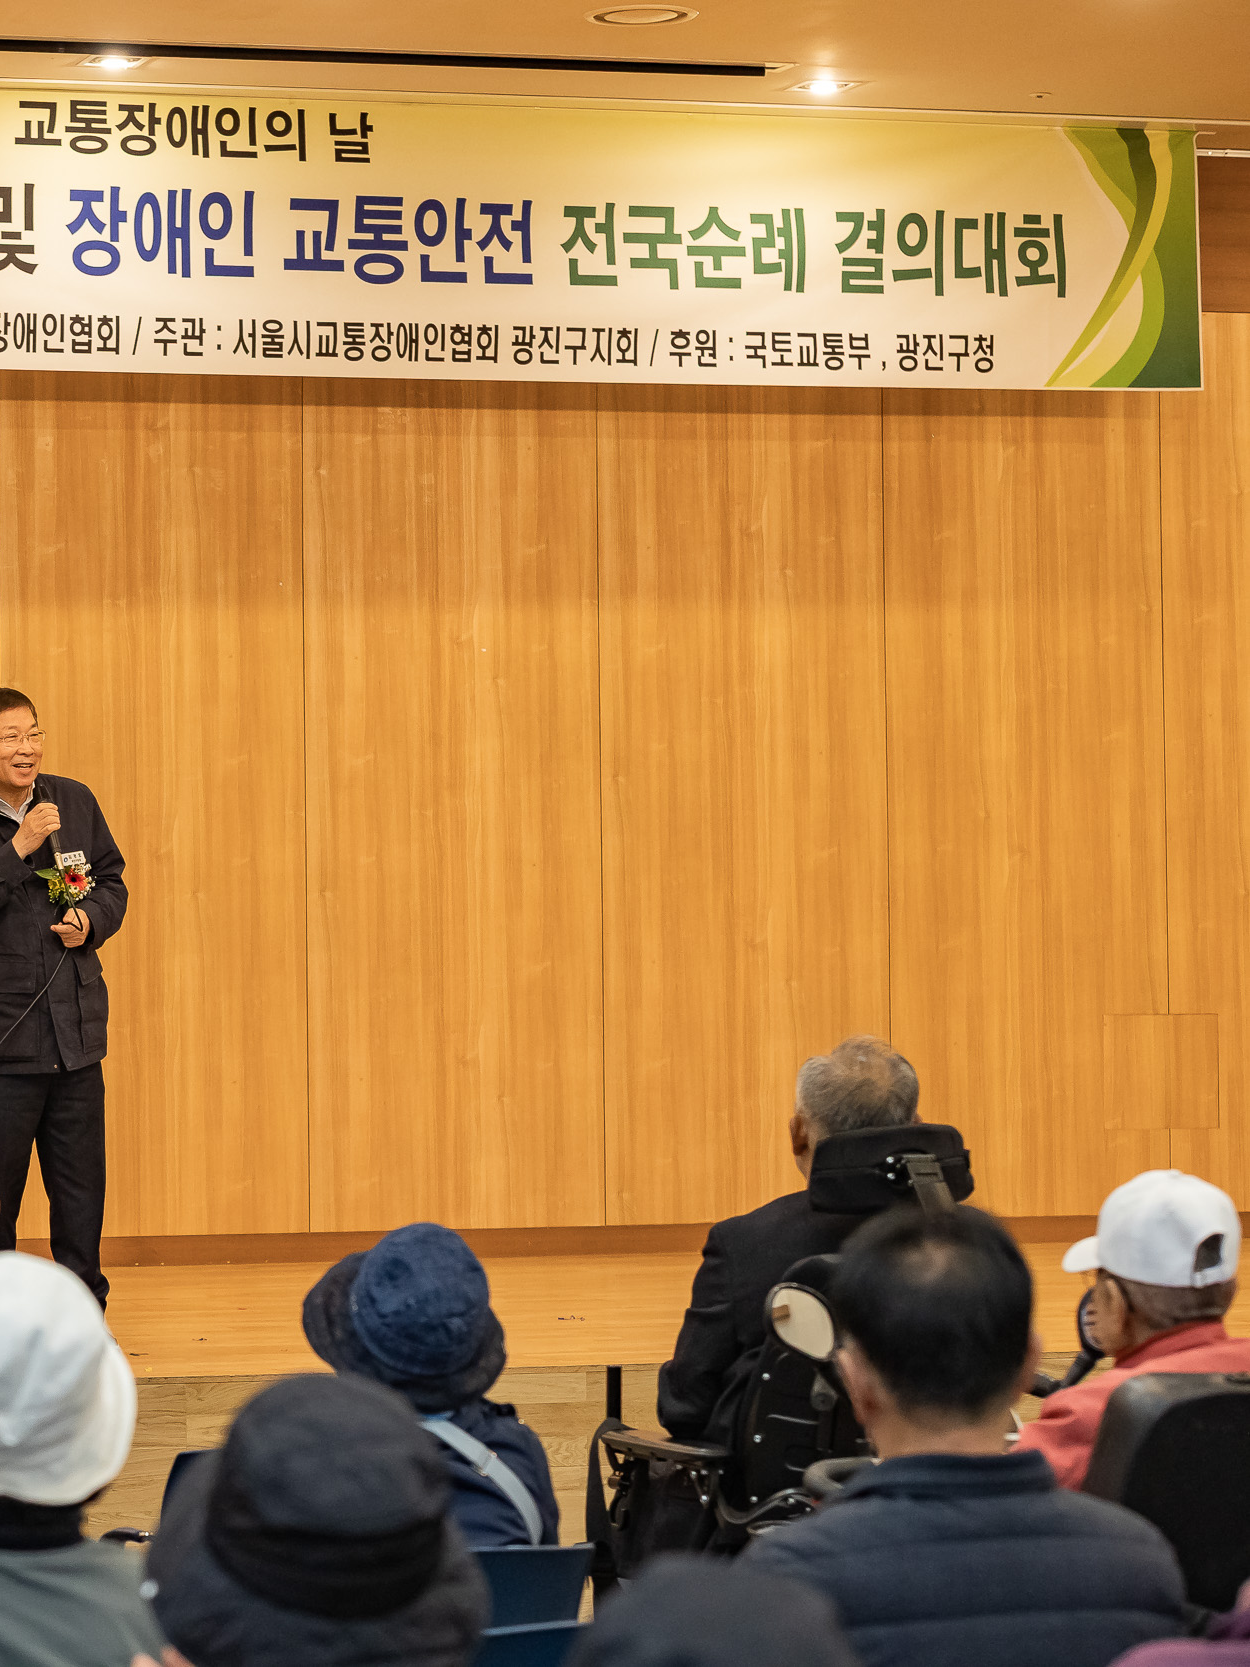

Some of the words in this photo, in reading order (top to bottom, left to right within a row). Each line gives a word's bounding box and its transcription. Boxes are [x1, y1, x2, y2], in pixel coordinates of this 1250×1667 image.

[14, 99, 307, 162] 교통장애인의
[328, 111, 374, 164] 날
[65, 185, 256, 279] 장애인
[283, 195, 534, 286] 교통안전
[559, 201, 807, 294] 전국순례
[834, 208, 1067, 299] 결의대회
[131, 316, 143, 356] /
[153, 316, 207, 357] 주관
[216, 324, 222, 351] :
[232, 318, 499, 364] 서울시교통장애인협회
[511, 325, 639, 367] 광진구지회
[649, 328, 660, 367] /
[668, 328, 718, 368] 후원
[728, 336, 734, 362] :
[744, 331, 871, 372] 국토교통부
[881, 360, 887, 372] ,
[896, 333, 995, 374] 광진구청
